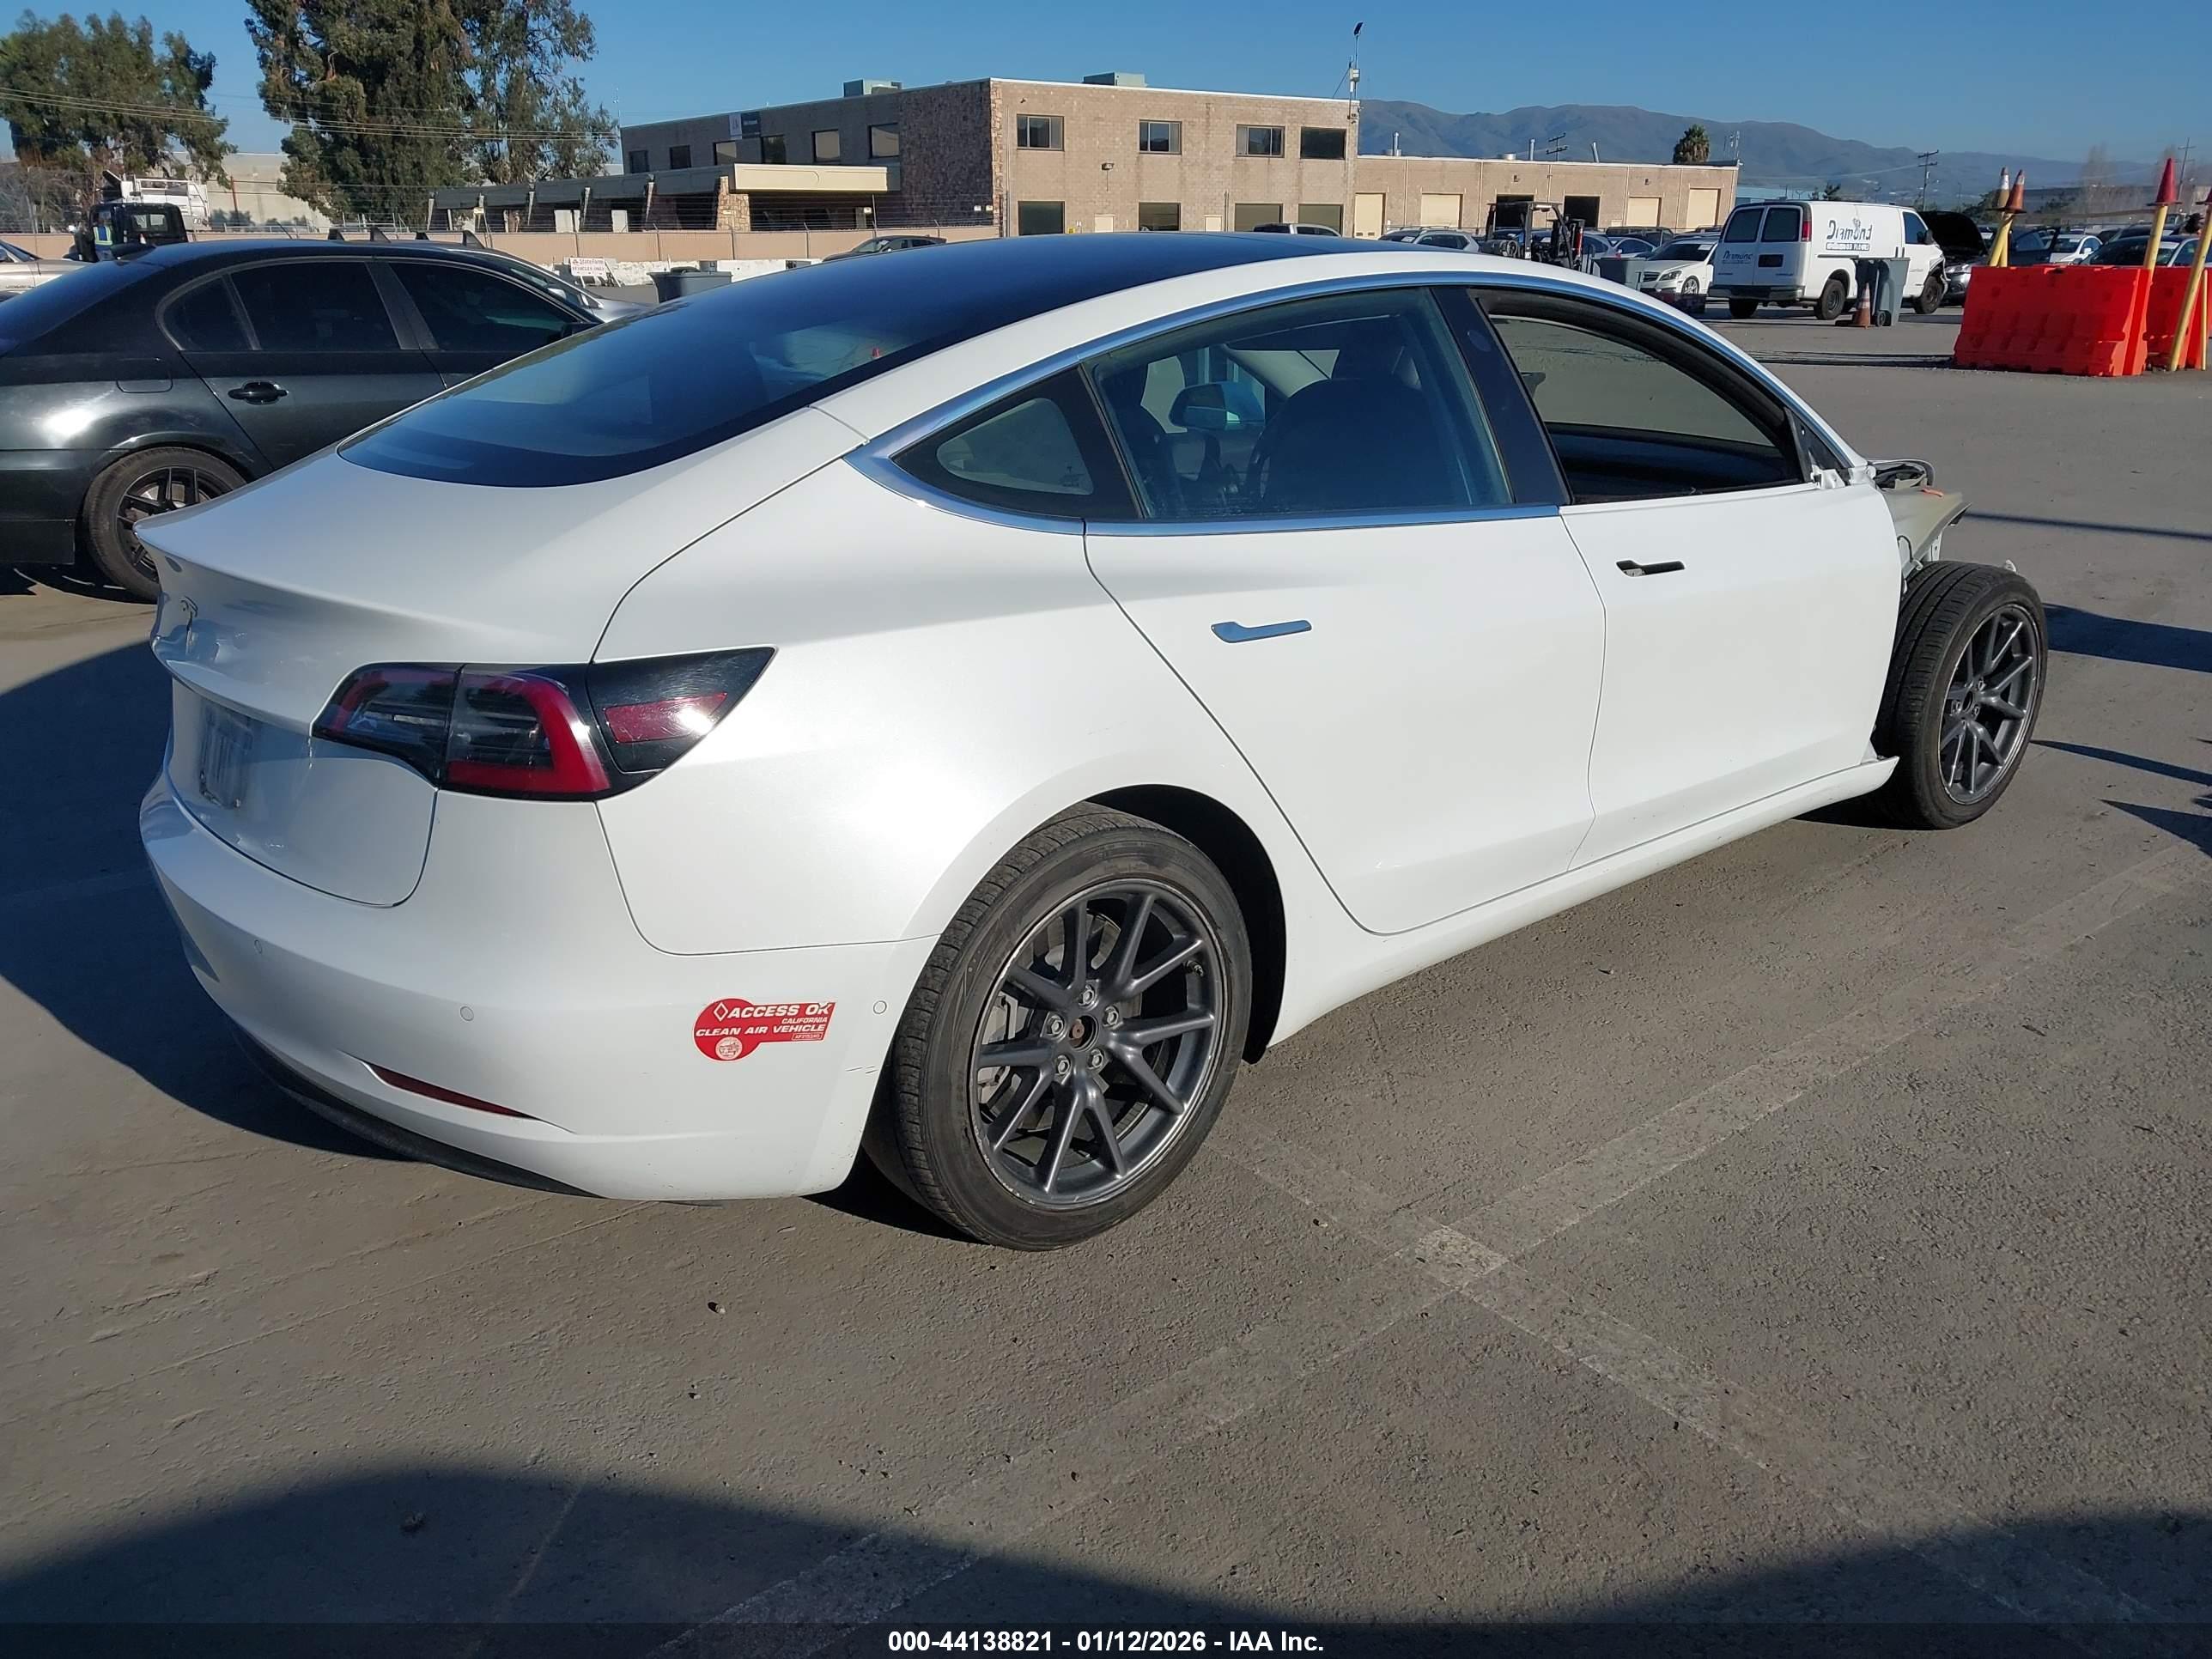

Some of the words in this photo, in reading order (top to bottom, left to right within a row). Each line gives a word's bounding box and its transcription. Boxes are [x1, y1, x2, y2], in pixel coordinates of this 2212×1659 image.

[1826, 219, 1872, 240] Diamond
[727, 1004, 800, 1018] ACCESS
[805, 1003, 833, 1015] OK
[696, 1027, 741, 1036] CLEAN
[744, 1026, 769, 1035] AIR
[773, 1024, 825, 1033] VEHICLE
